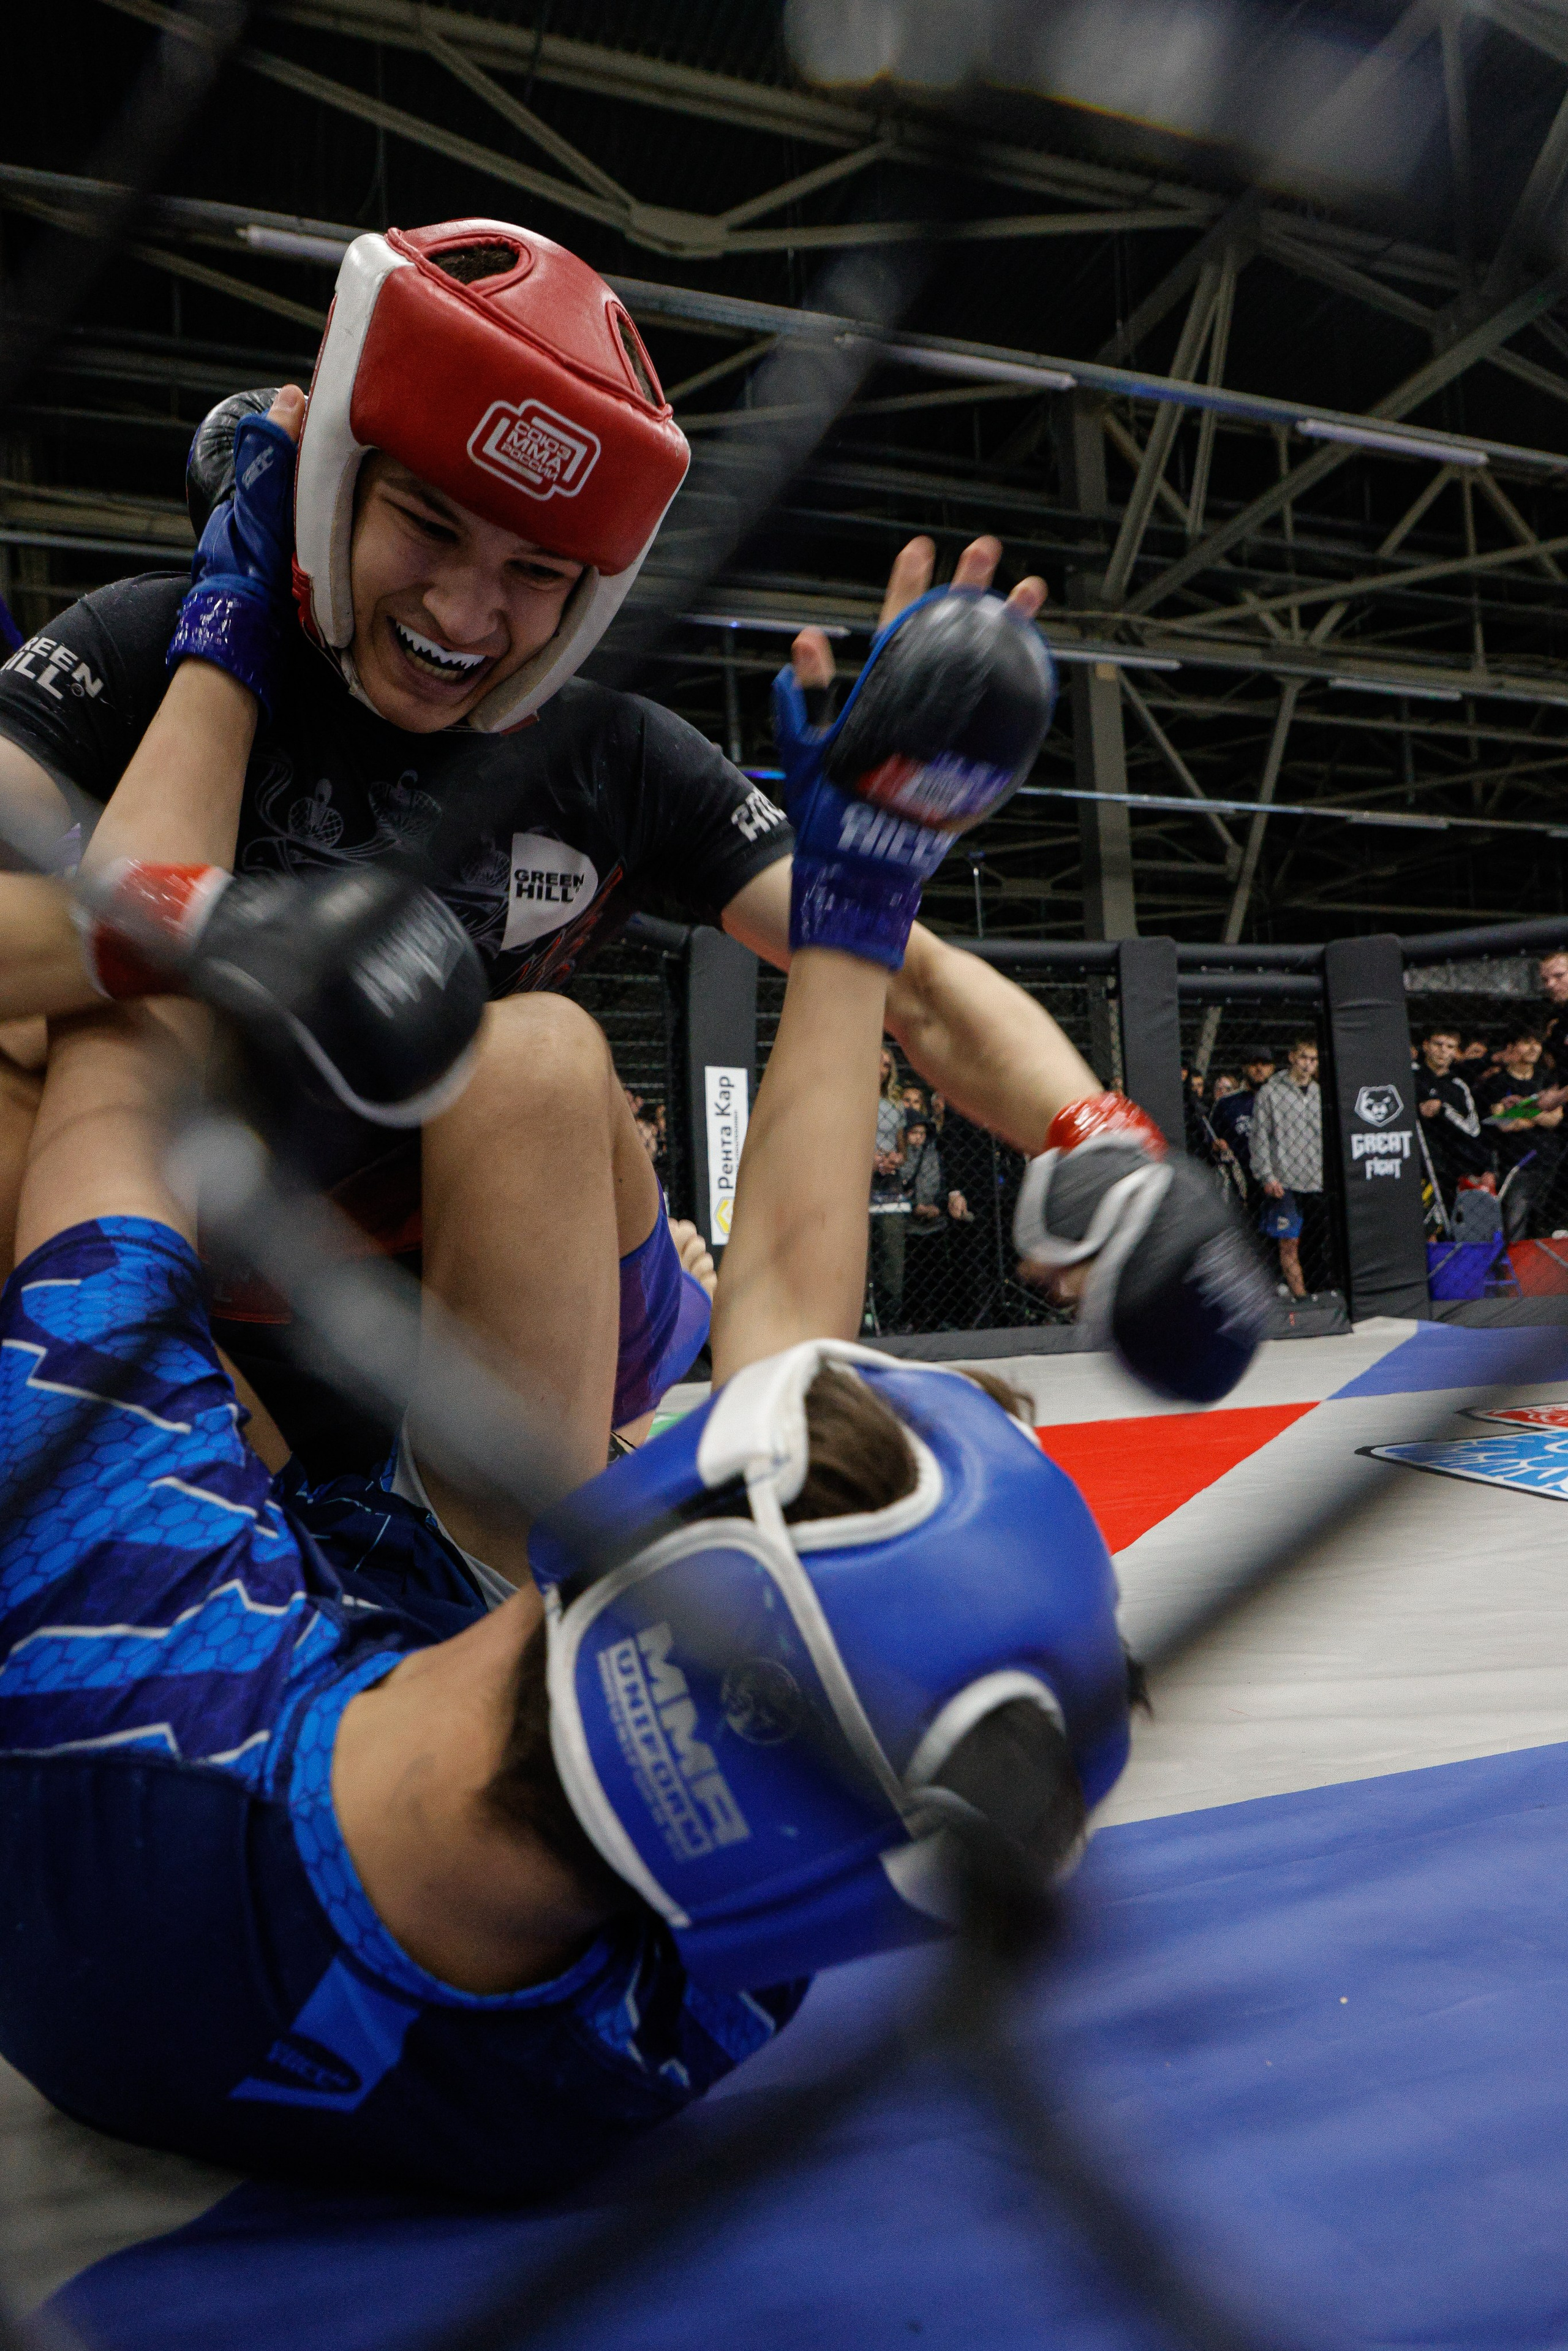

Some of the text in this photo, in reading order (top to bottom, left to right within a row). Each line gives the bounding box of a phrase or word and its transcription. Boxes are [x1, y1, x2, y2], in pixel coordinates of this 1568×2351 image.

[514, 420, 572, 459] СОЮЗ
[501, 442, 559, 481] РОССИИ
[17, 637, 104, 698] REEN
[514, 869, 585, 888] GREEN
[516, 883, 574, 902] HILL
[714, 1076, 734, 1189] Рента Кар
